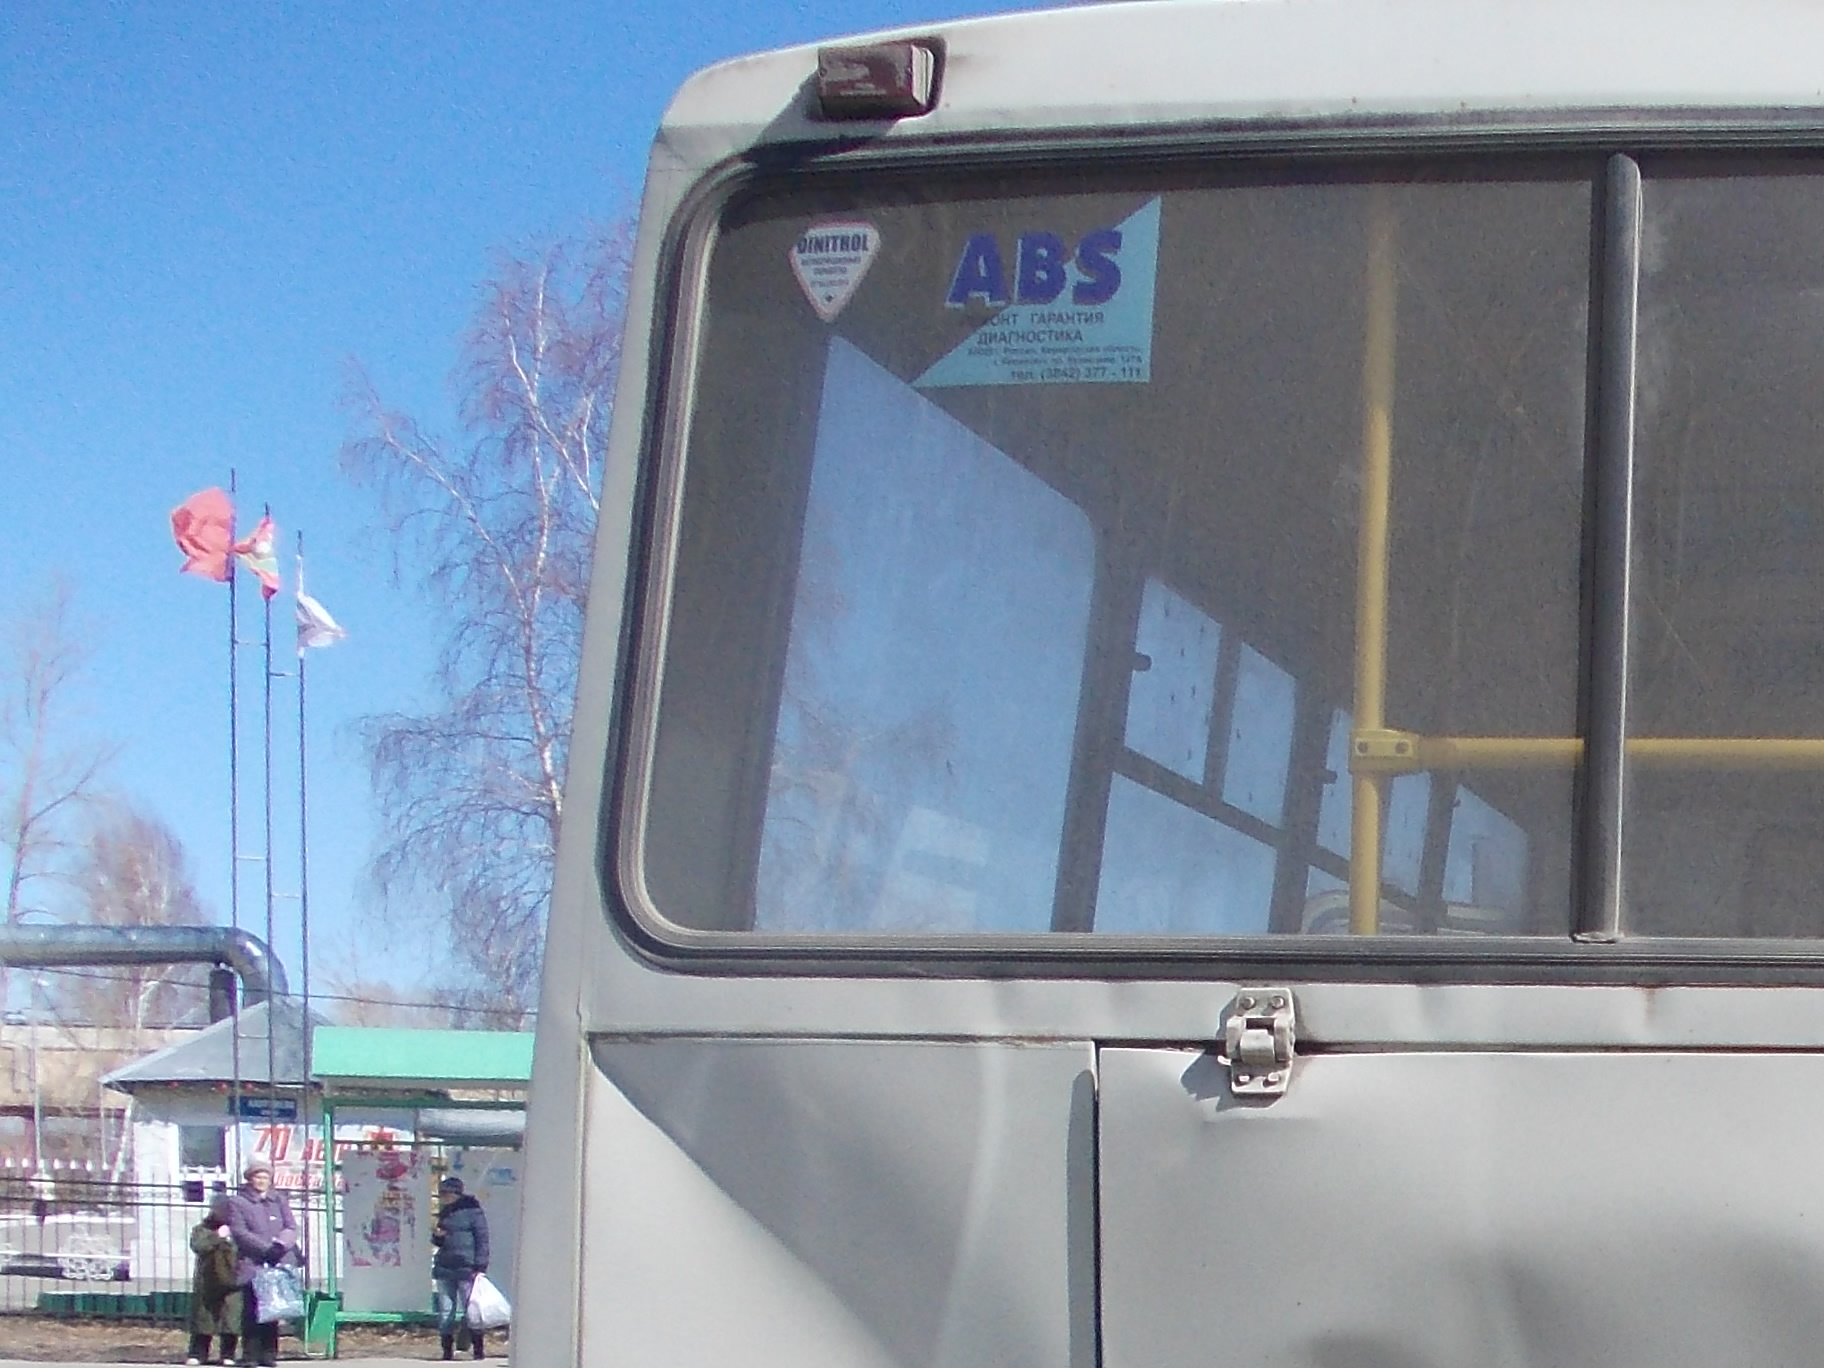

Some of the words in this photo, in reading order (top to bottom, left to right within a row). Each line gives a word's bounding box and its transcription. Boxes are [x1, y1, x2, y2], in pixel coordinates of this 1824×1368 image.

[796, 233, 869, 254] DINITROL
[944, 229, 1122, 307] ABS
[1030, 310, 1105, 326] ГАРАНТИЯ
[976, 328, 1084, 346] ДИАГНОСТИКА
